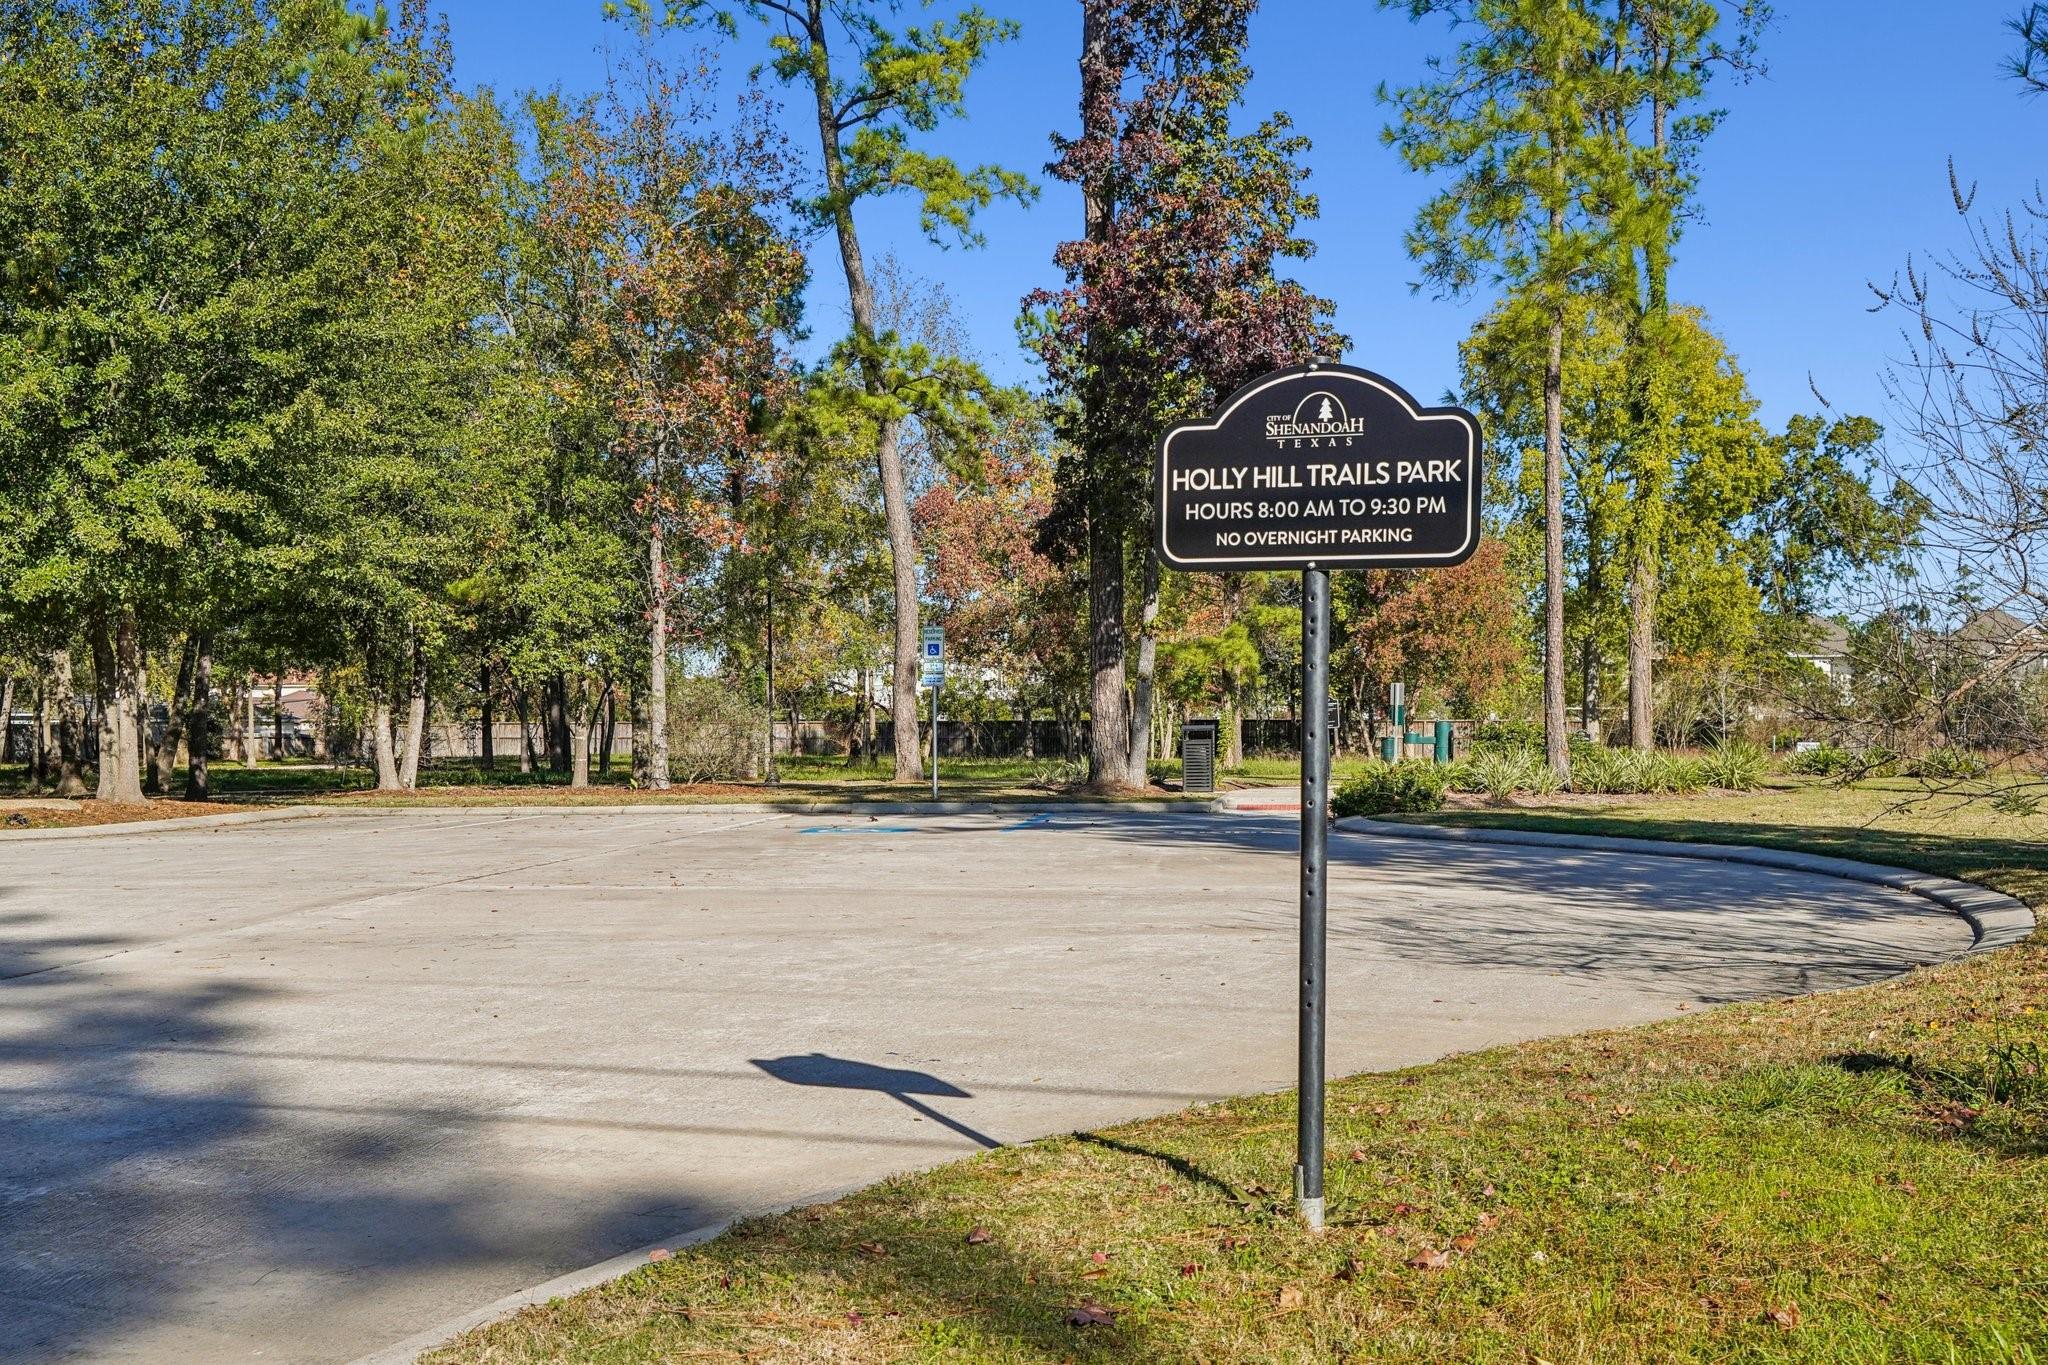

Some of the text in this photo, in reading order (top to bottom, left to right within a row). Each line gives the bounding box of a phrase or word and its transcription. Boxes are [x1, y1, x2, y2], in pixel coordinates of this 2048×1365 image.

[1282, 414, 1292, 422] OF
[1277, 437, 1353, 449] TEXAS
[1172, 458, 1461, 492] HOLLY HILL TRAILS PARK
[1185, 495, 1447, 521] HOURS 8:00 AM TO 9:30 PM
[1216, 527, 1413, 547] NO OVERNIGHT PARKING
